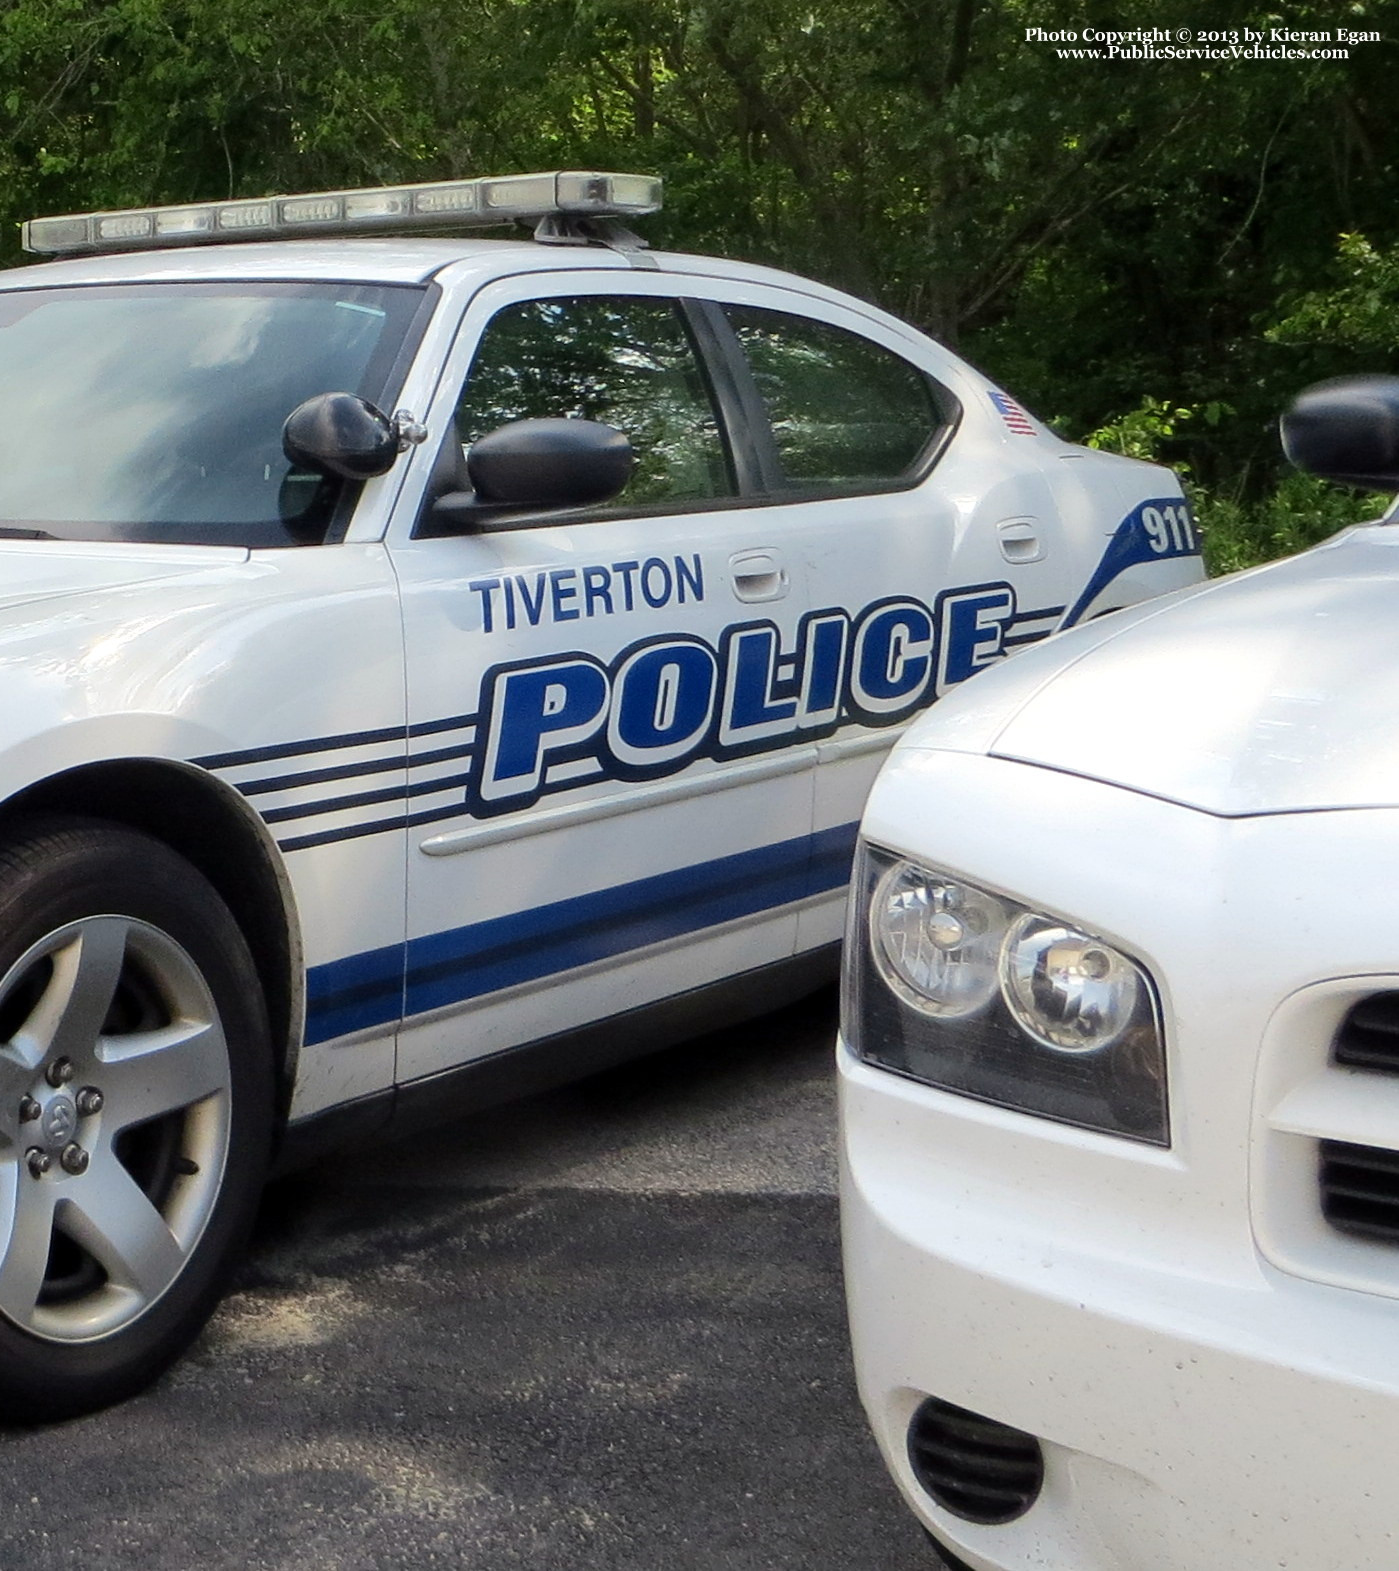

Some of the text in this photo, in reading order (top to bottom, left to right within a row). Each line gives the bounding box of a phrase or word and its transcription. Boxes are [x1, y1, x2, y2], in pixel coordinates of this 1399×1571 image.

[1141, 504, 1196, 554] 911
[468, 553, 705, 634] TIVERTON
[479, 587, 1013, 801] POLICE
